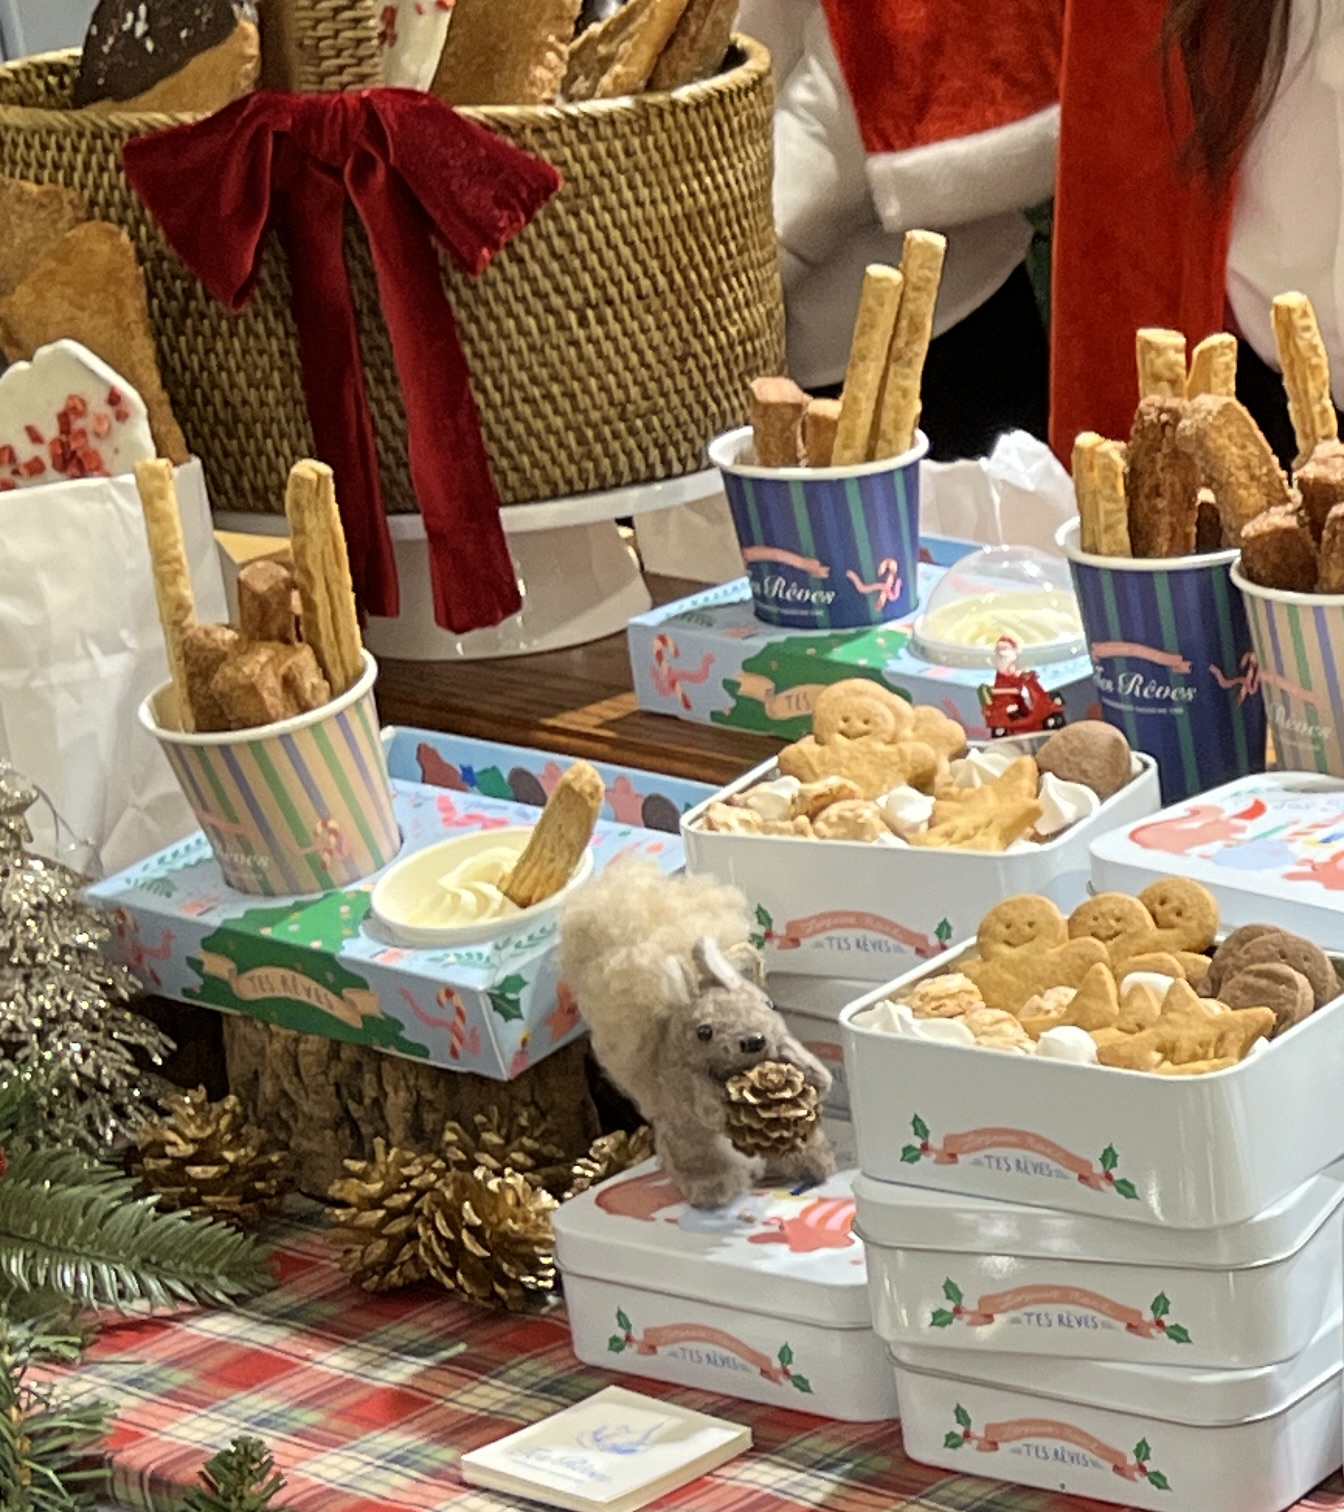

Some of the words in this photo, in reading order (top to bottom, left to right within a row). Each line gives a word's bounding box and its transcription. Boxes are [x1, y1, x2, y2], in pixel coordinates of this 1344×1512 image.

[1119, 673, 1197, 702] Rêves
[825, 936, 850, 951] TES
[984, 1155, 1011, 1172] TES
[1025, 1312, 1052, 1327] TES
[679, 1347, 701, 1362] TES
[1023, 1443, 1049, 1458] TES
